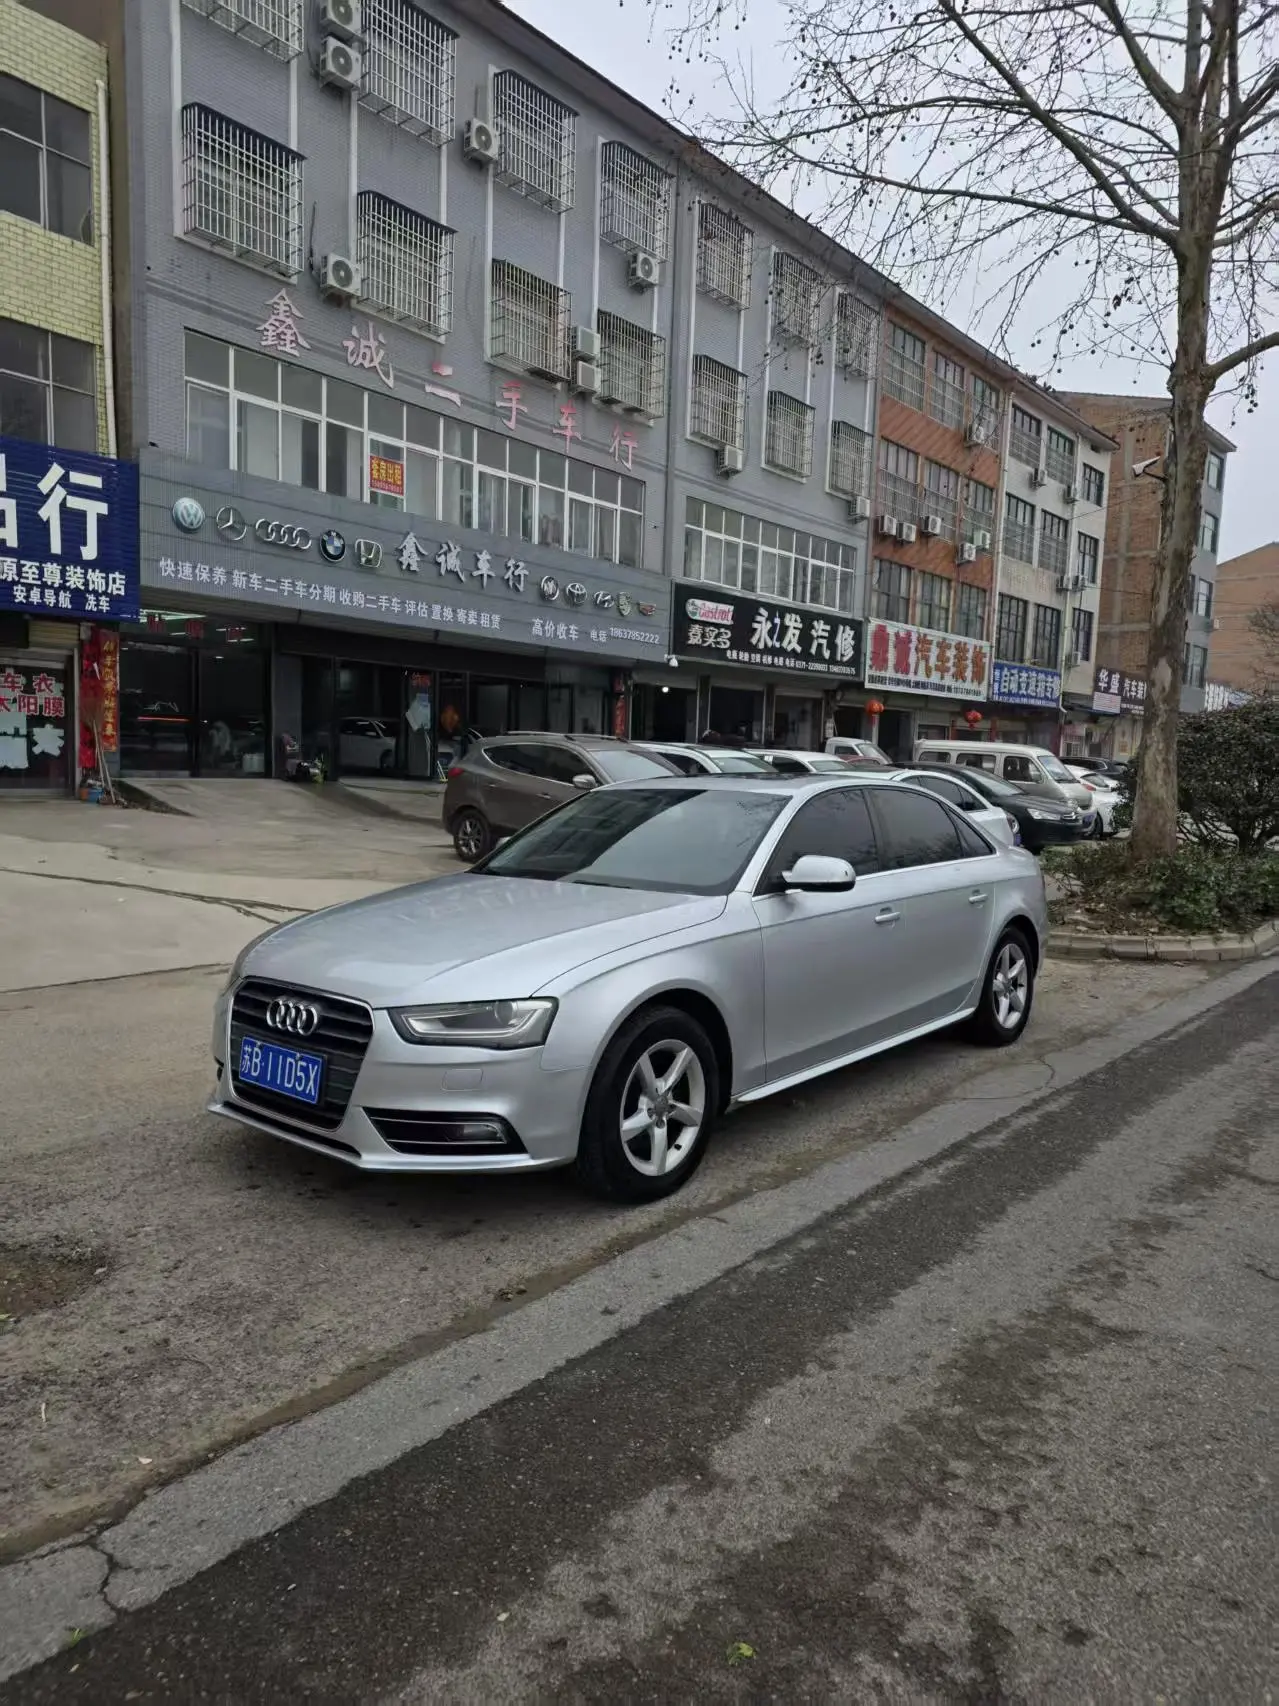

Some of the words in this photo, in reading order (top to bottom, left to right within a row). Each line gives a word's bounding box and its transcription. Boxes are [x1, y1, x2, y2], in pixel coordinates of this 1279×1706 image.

[256, 288, 637, 471] 鑫诚二手车行
[0, 453, 109, 561] 行
[398, 531, 529, 593] 鑫诚车行
[13, 585, 72, 609] 安卓导航
[85, 593, 111, 613] 洗车
[159, 556, 227, 586] 快速保养
[232, 570, 336, 604] 新车二手车分期
[338, 588, 402, 613] 收购二手车
[404, 599, 429, 618] 评估
[431, 603, 454, 622] 置换
[456, 607, 479, 626] 寄卖
[480, 611, 501, 630] 租赁
[531, 617, 580, 642] 高价收车
[590, 630, 608, 643] 电话
[609, 626, 660, 645] 18637852222
[687, 623, 732, 649] 嘉实多
[750, 606, 856, 662] 永发汽修
[1122, 678, 1147, 700] 汽车装
